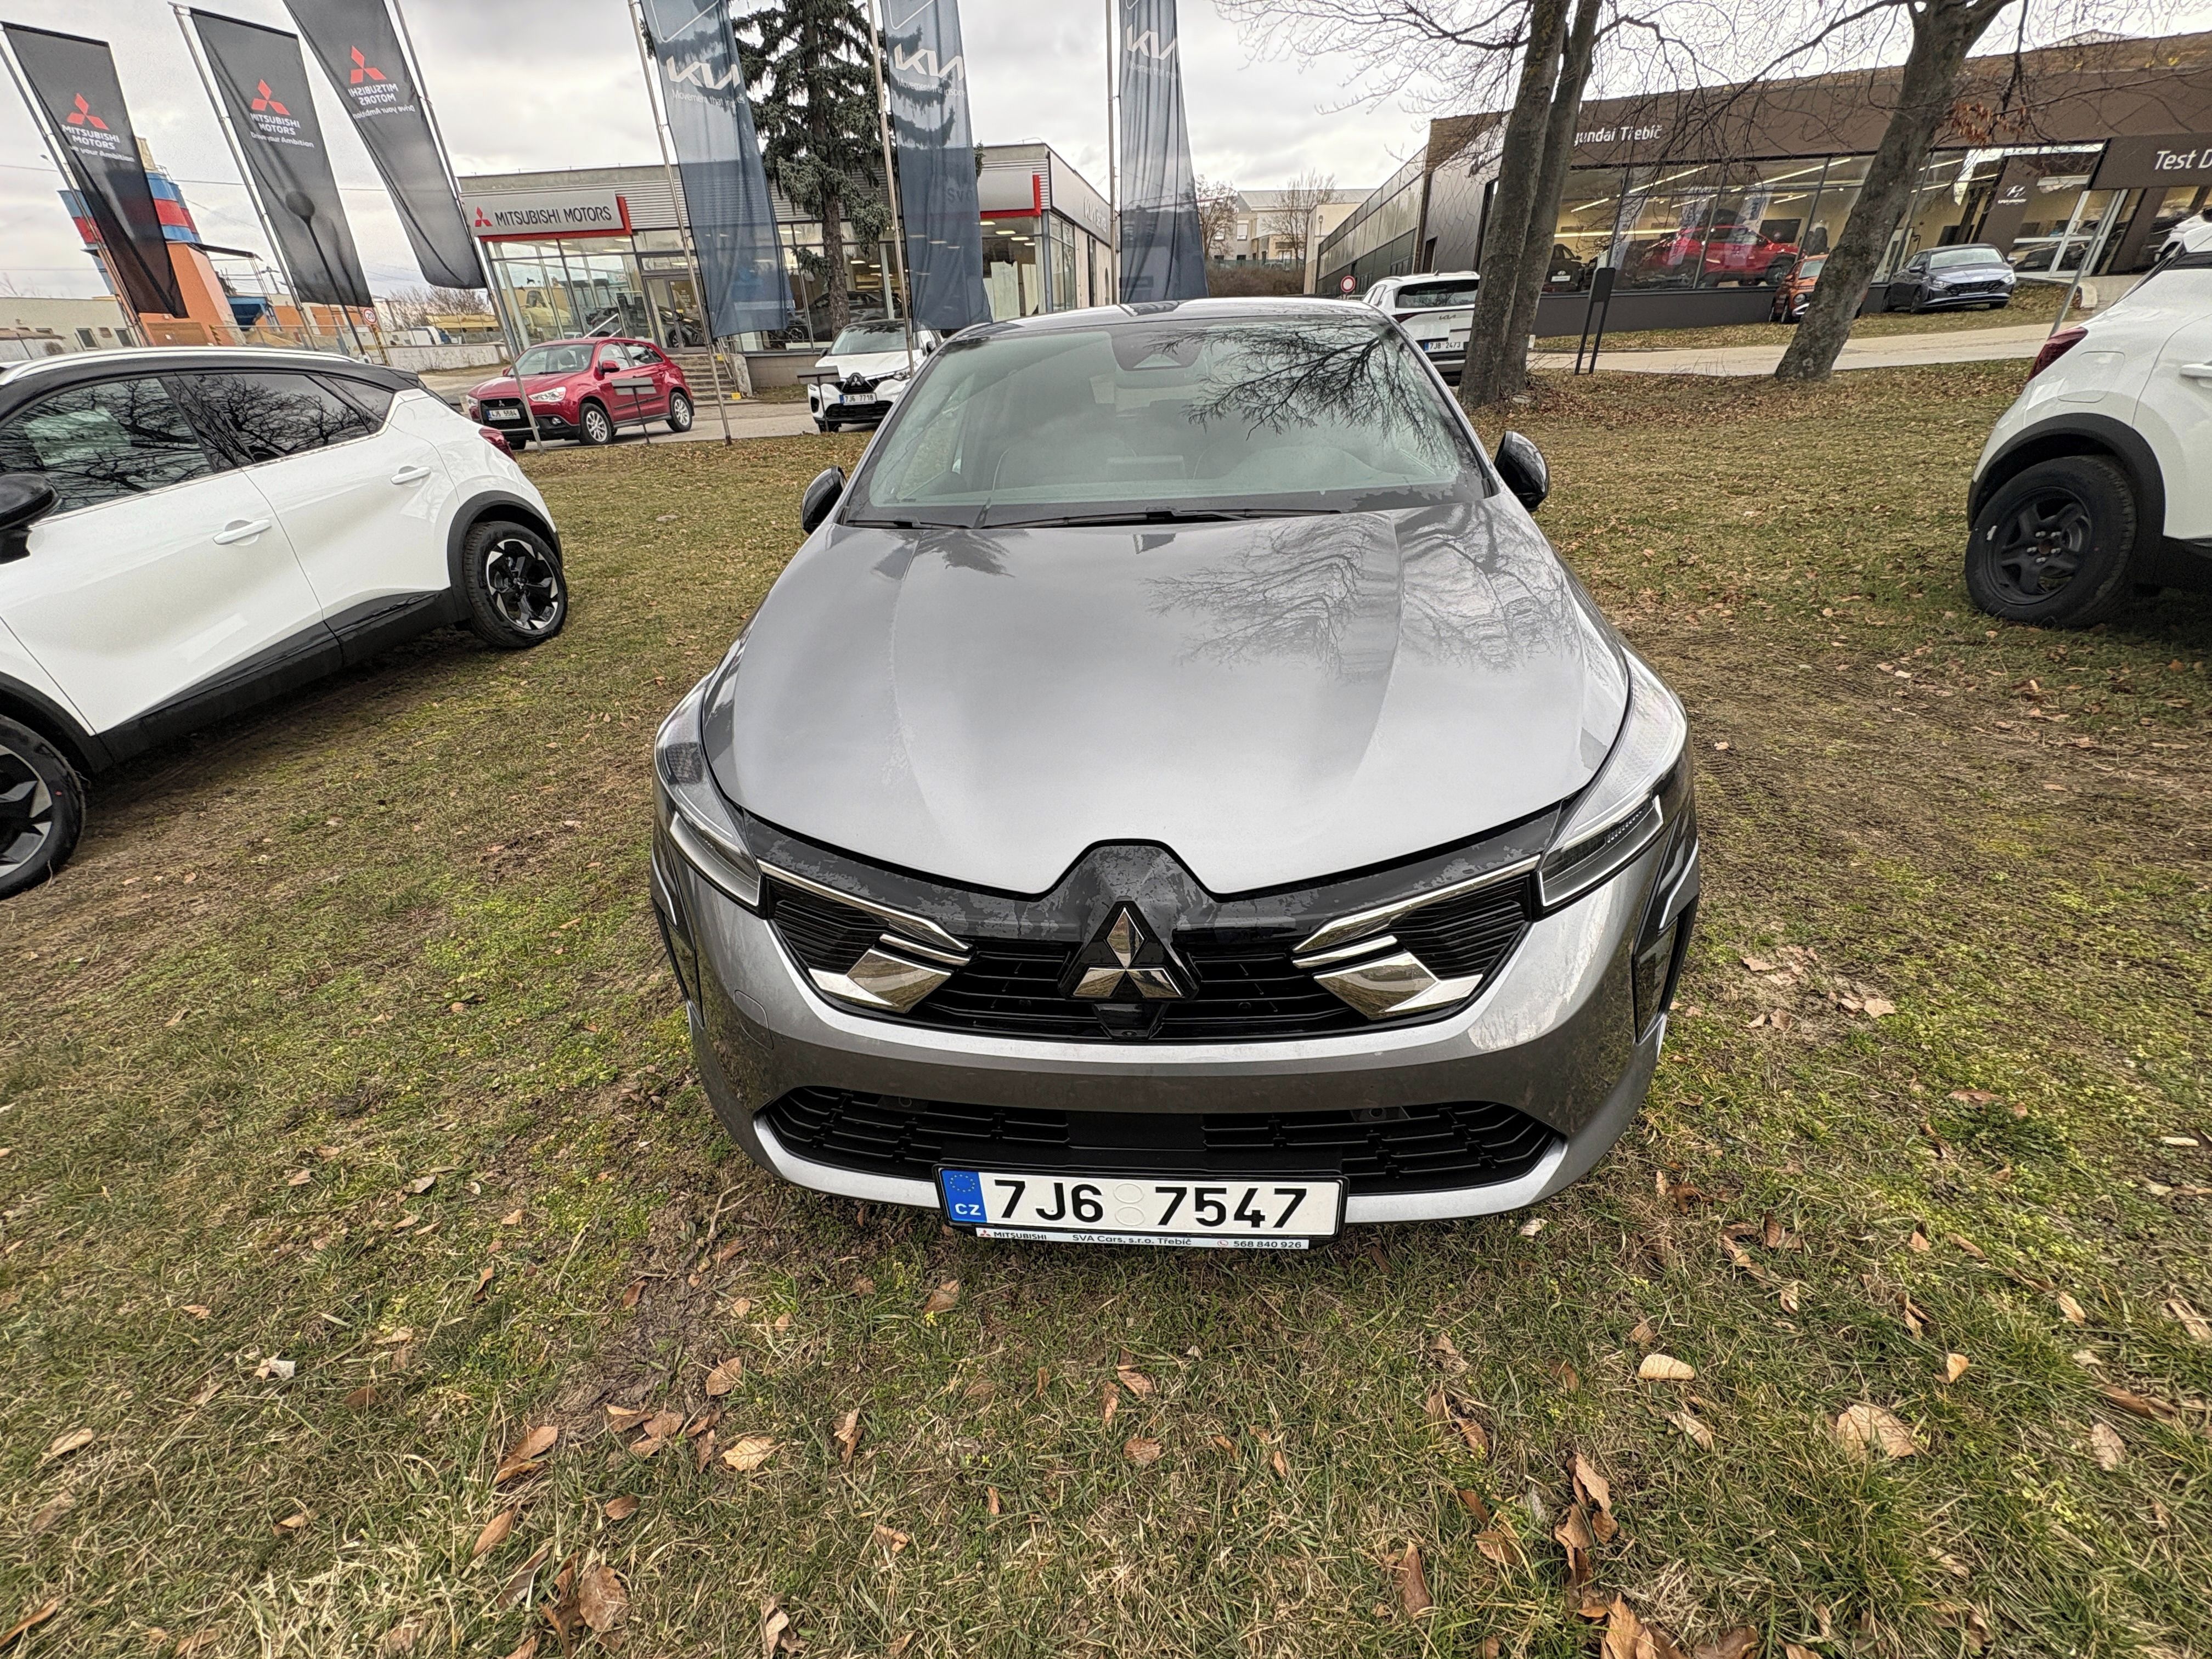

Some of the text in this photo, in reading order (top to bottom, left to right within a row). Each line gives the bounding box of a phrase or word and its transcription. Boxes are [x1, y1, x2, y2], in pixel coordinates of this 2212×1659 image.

[894, 43, 964, 81] KIA
[666, 55, 741, 90] KIA
[250, 113, 301, 129] MITSUBISHI
[258, 122, 296, 136] MOTORS
[61, 124, 121, 143] MITSUBISHI
[72, 135, 116, 150] MOTORS
[281, 137, 315, 149] Ambition
[1573, 127, 1617, 146] yundai
[2154, 149, 2197, 170] Test
[494, 206, 612, 227] MITSUBISHI MOTORS
[955, 1179, 1307, 1228] CZ 7J6 7547
[993, 1231, 1047, 1240] MITSUBISHI
[1097, 1235, 1126, 1243] Cars,
[1157, 1237, 1192, 1245] Třebíč
